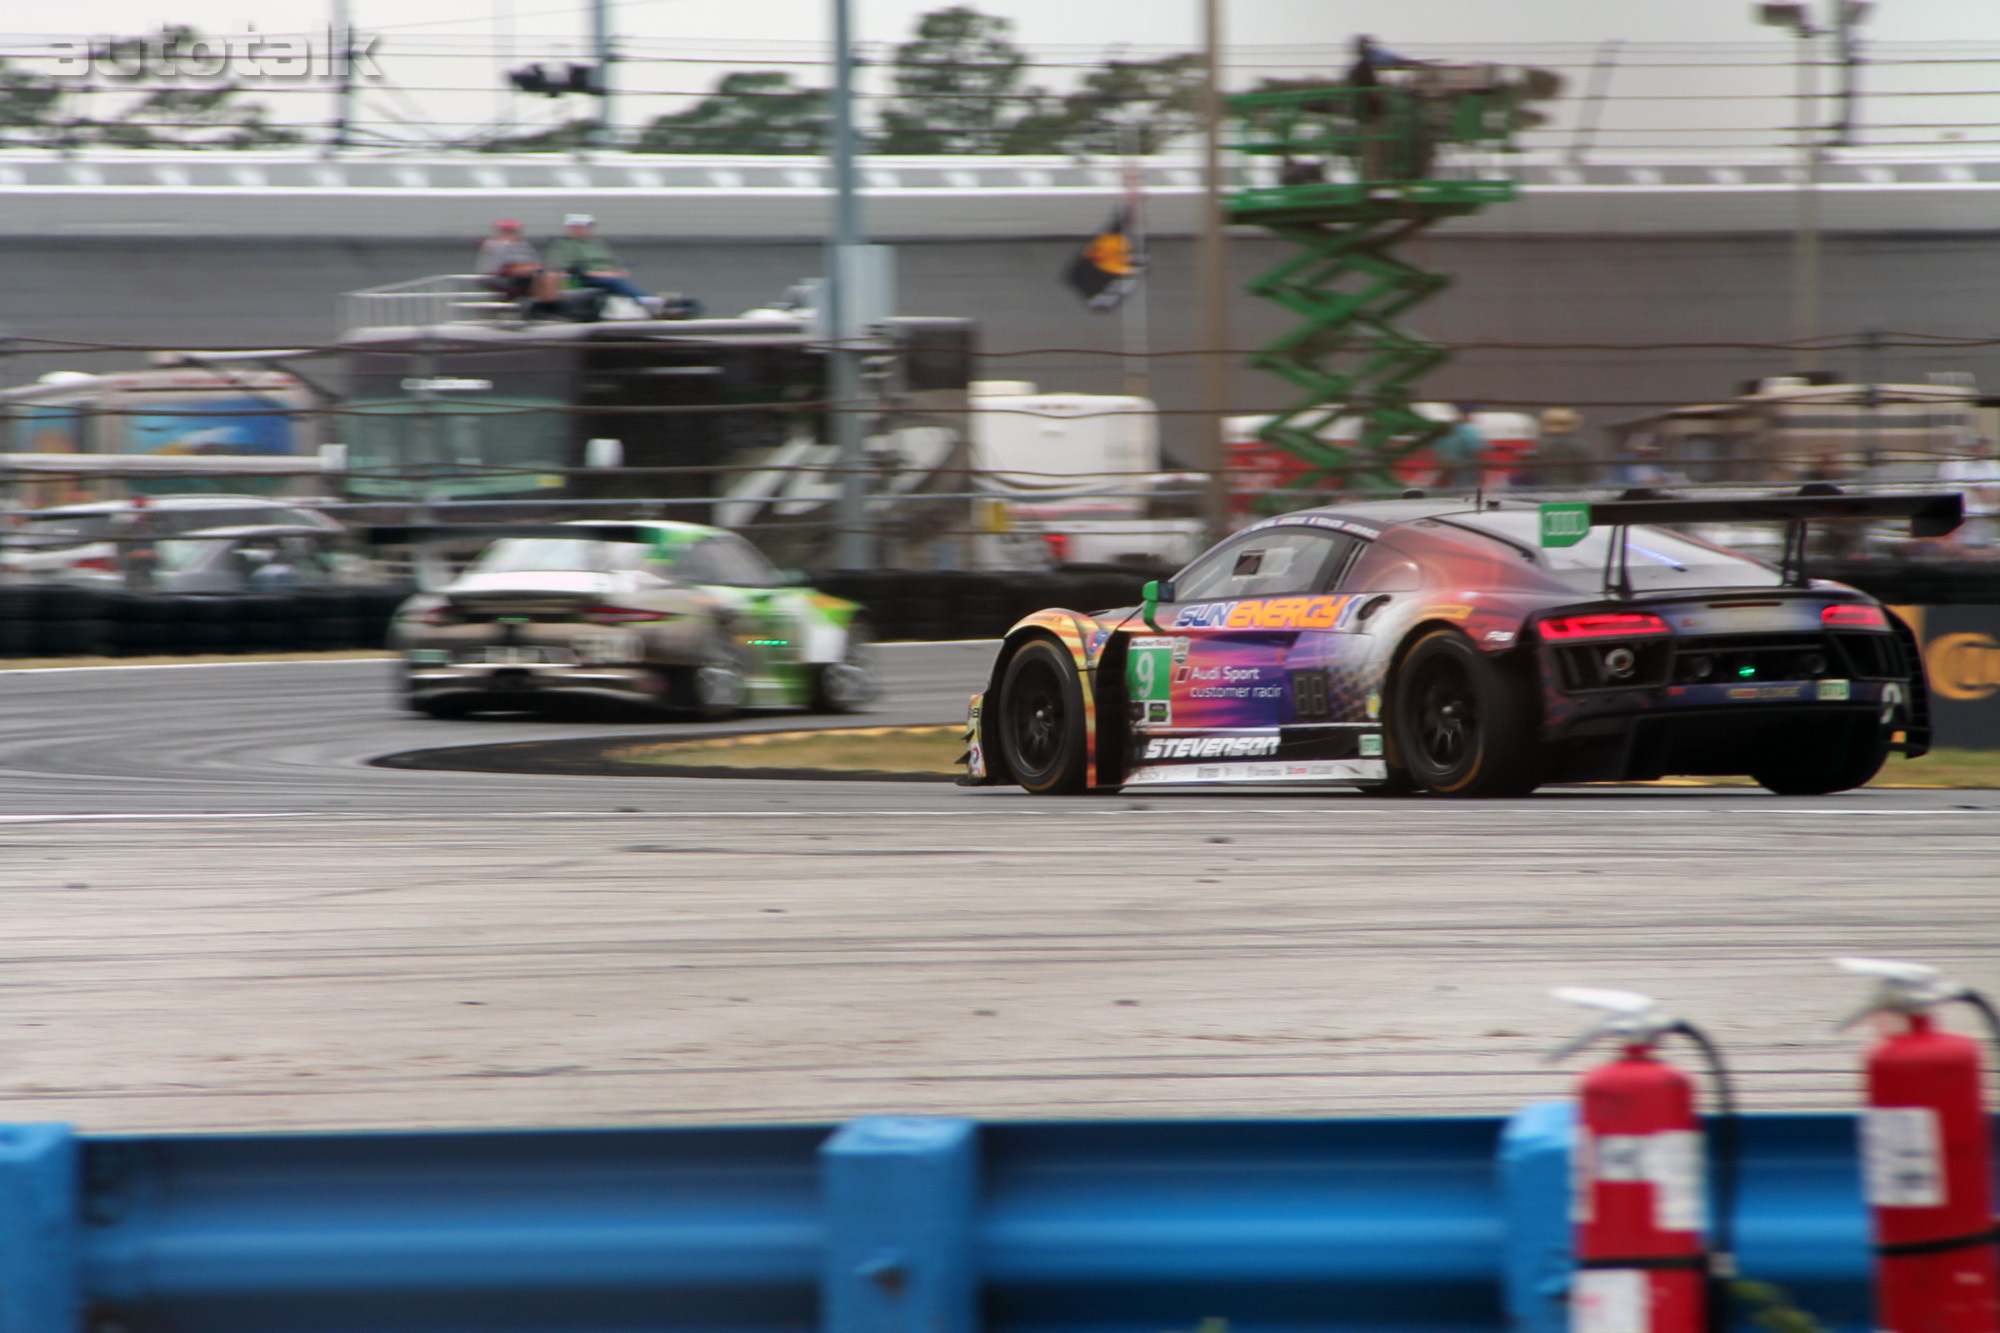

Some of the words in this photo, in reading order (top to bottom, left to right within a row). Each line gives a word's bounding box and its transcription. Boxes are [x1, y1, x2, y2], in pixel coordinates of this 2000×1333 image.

[1136, 651, 1154, 698] 9
[1190, 666, 1221, 680] Audi
[1223, 666, 1260, 682] Sport
[1190, 686, 1250, 698] customer
[1143, 736, 1282, 759] STEVENSON
